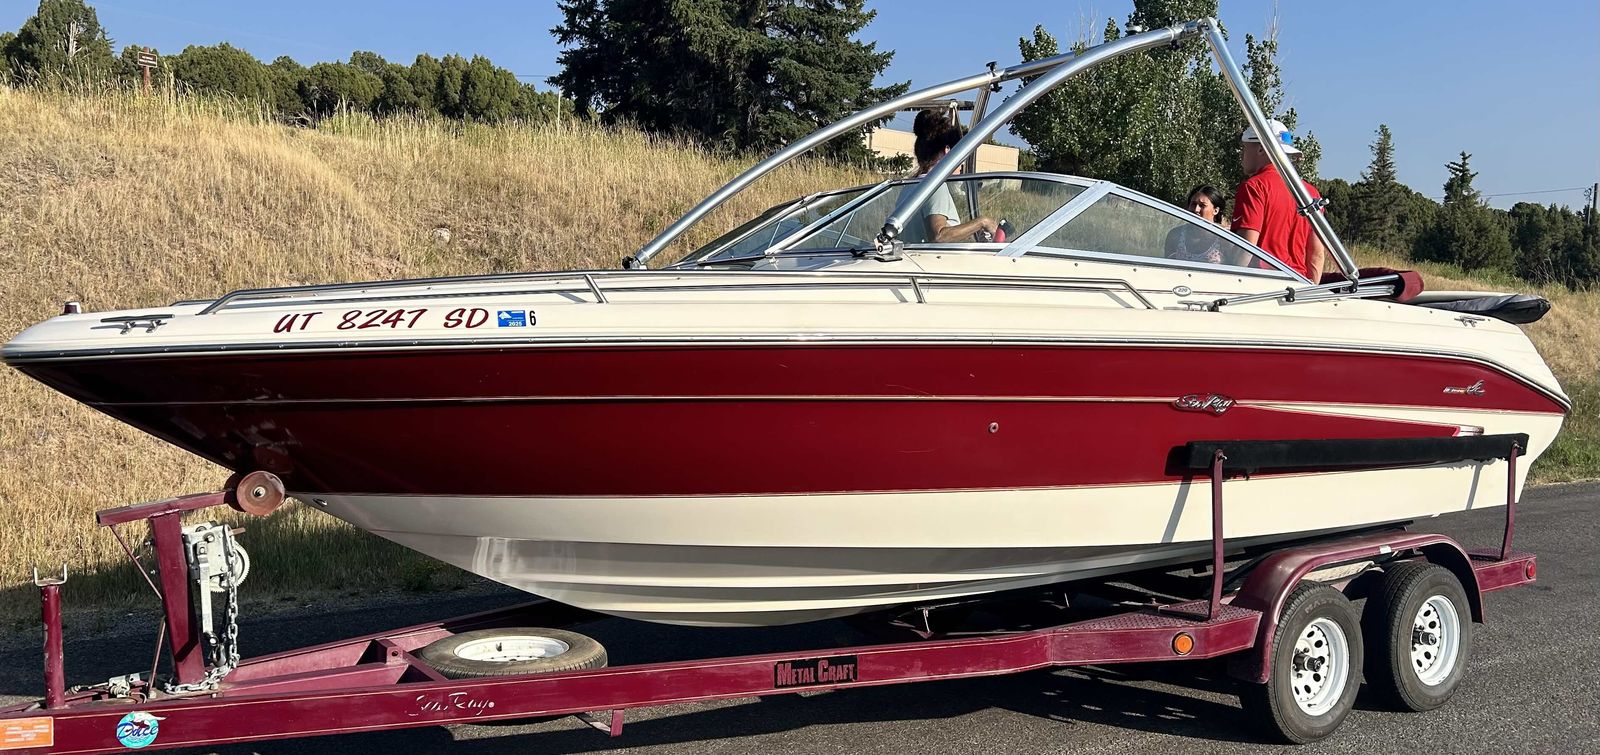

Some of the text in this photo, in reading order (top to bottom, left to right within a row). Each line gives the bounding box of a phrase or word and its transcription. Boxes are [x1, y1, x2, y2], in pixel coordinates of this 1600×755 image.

[273, 308, 489, 333] UT 8247 SD
[529, 310, 537, 326] 6
